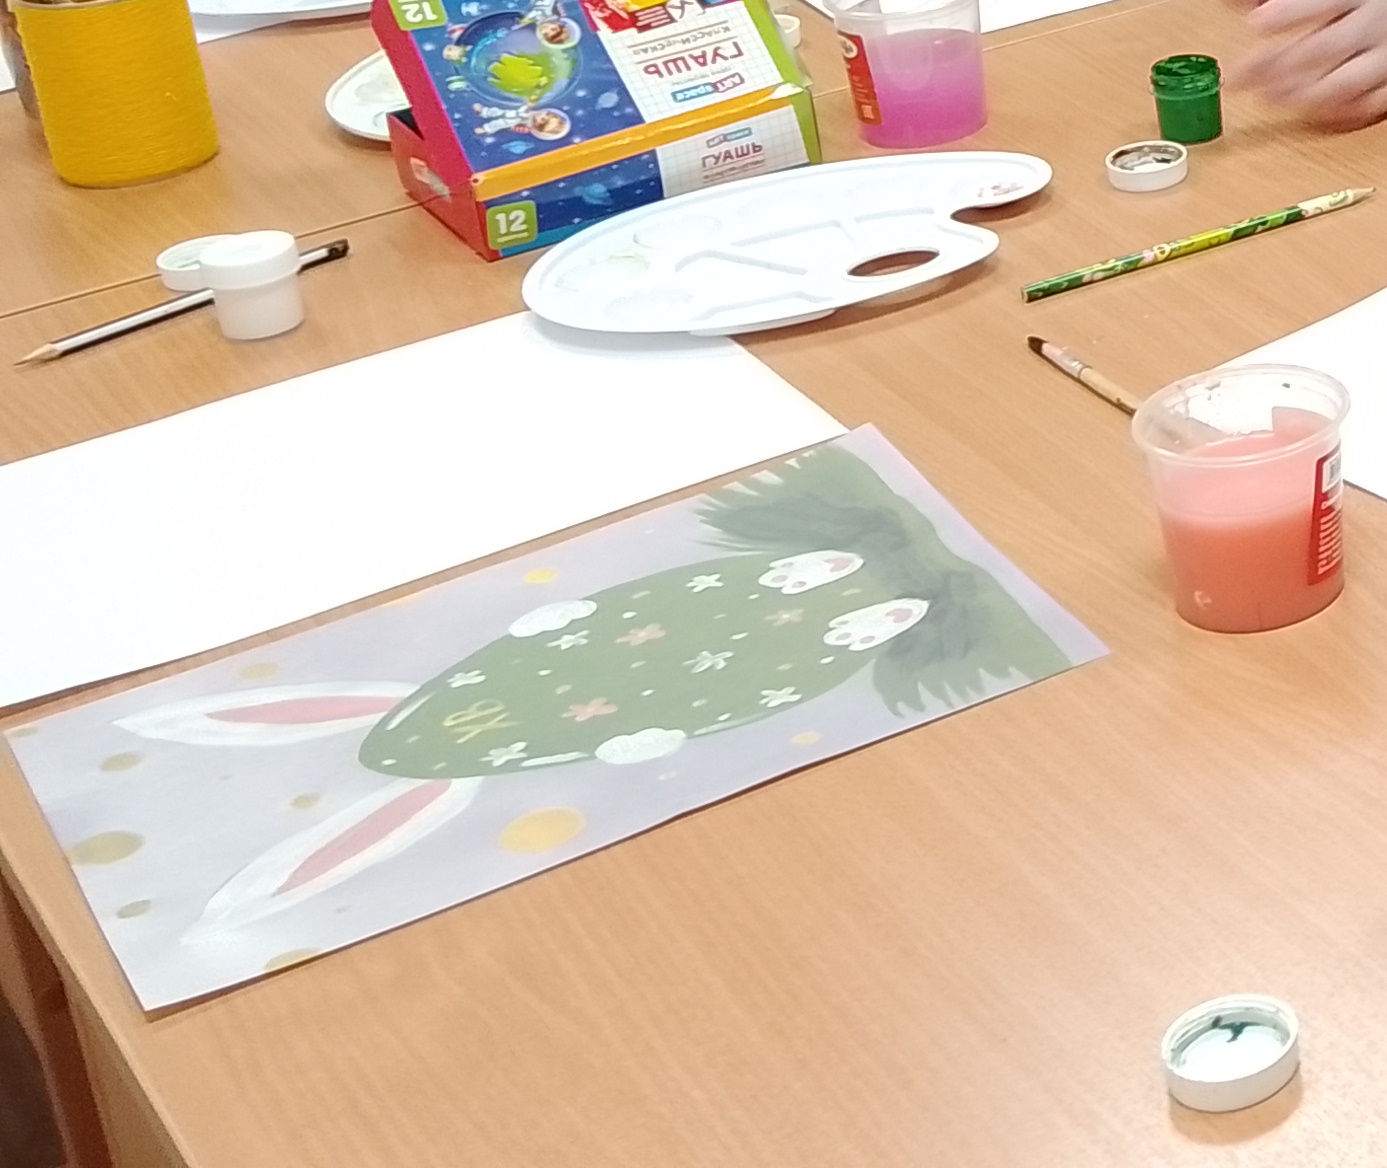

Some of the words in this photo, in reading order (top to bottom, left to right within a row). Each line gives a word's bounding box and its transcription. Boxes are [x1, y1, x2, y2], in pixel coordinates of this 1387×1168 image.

[401, 1, 438, 23] 12
[643, 41, 744, 79] ГУАШЬ
[701, 142, 763, 169] ГУАШЬ
[495, 209, 529, 235] 12
